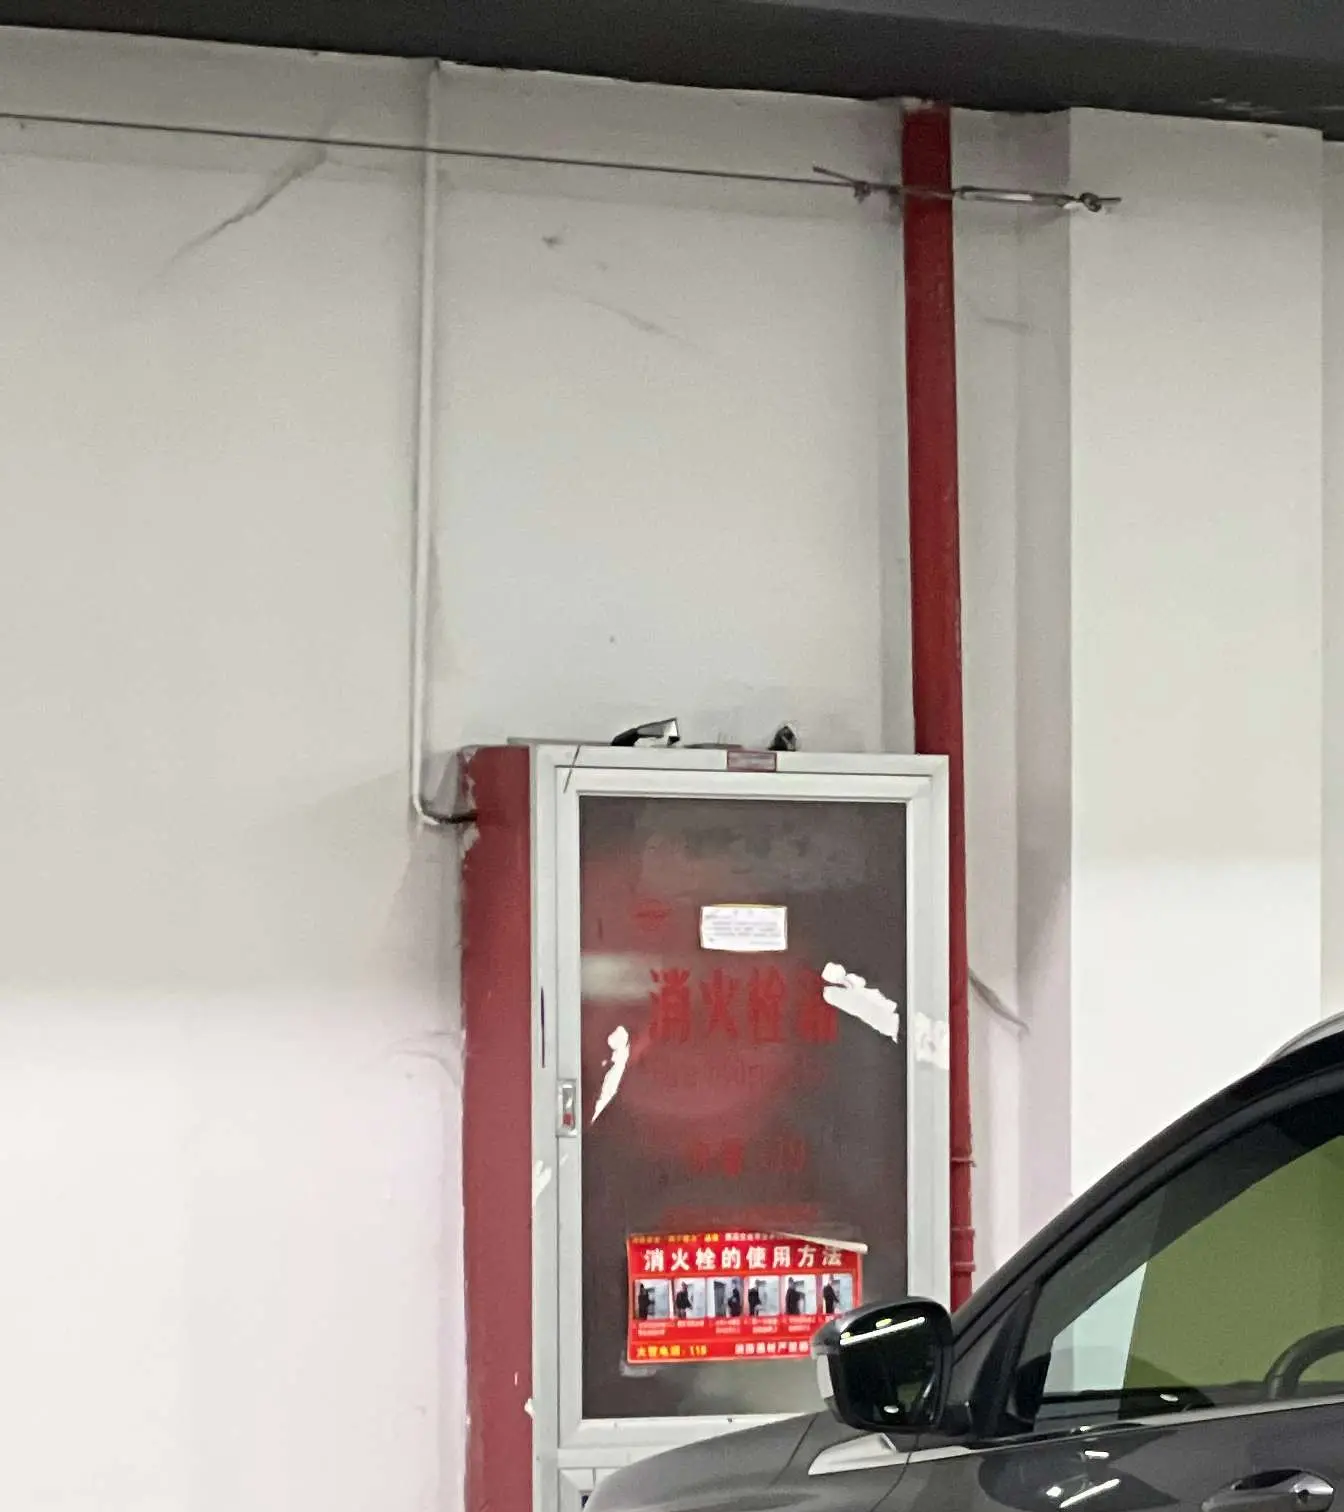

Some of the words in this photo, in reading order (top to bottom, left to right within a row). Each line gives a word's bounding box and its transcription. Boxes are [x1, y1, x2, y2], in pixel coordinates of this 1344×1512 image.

[644, 1245, 843, 1272] 消火栓的使用方法
